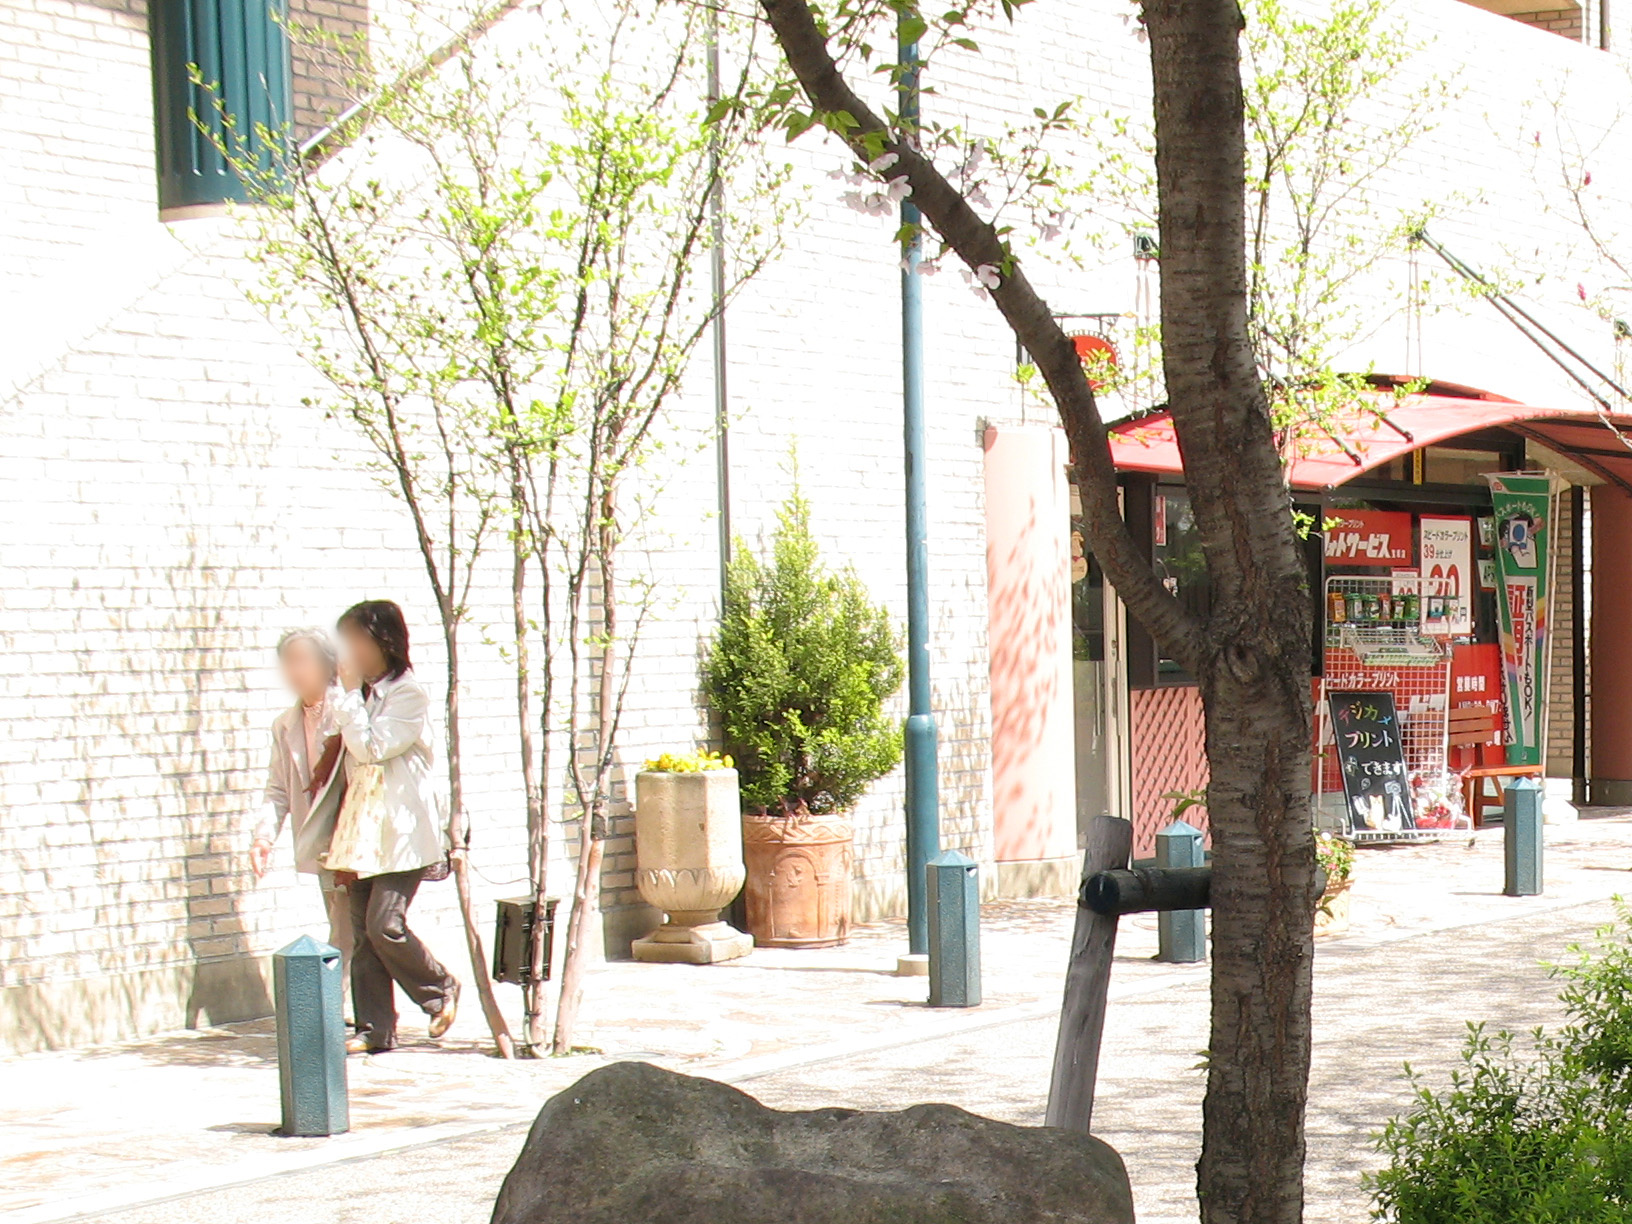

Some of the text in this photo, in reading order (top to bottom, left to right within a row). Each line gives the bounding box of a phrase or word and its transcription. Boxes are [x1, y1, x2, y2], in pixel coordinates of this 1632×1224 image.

[1318, 671, 1400, 690] ピードカラープリント
[1344, 730, 1394, 749] プリント
[1361, 760, 1403, 776] できます
